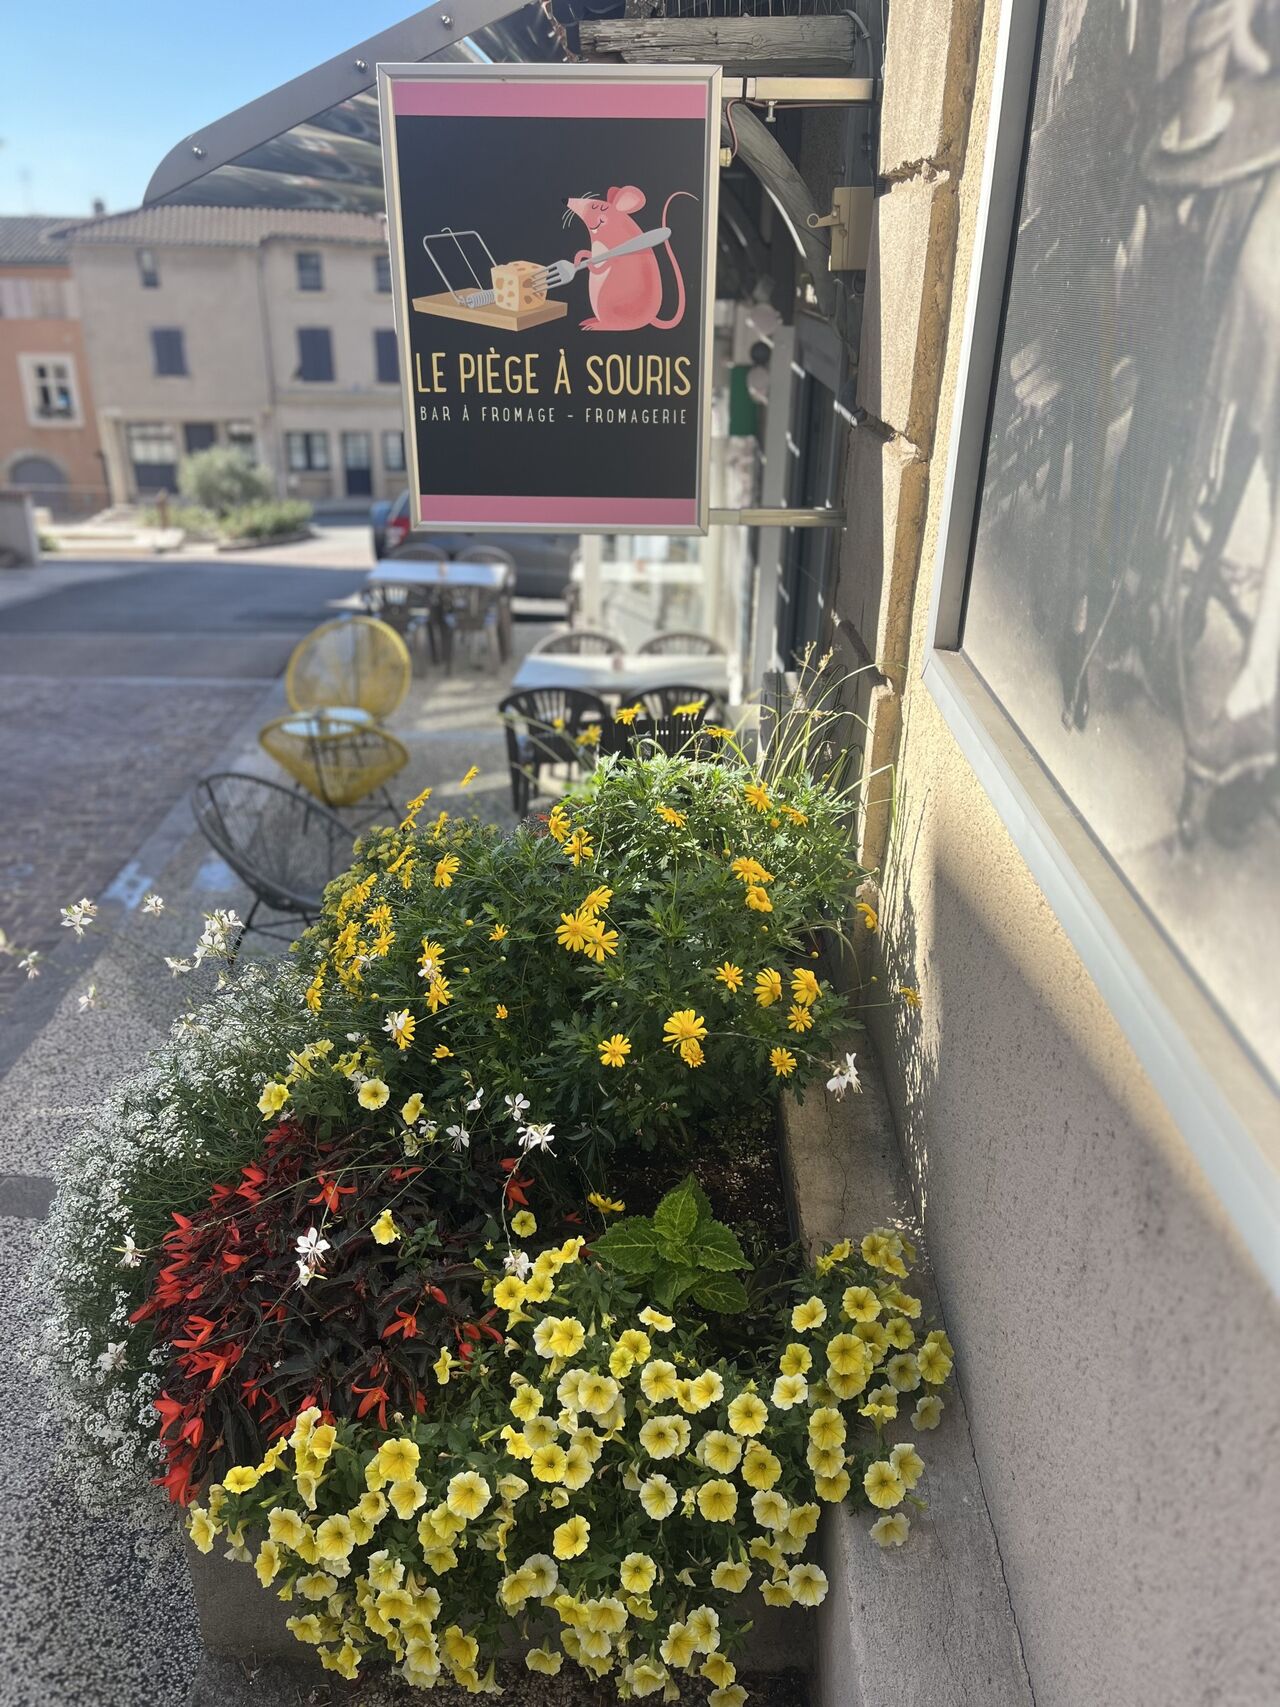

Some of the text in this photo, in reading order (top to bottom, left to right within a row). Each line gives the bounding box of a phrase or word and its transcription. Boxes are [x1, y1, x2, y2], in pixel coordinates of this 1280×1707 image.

[415, 347, 691, 396] LE PIÈGE À SOURIS
[420, 406, 451, 421] BAR
[462, 404, 470, 422] À
[481, 406, 556, 422] FROMAGE
[585, 407, 687, 425] FROMAGERIE
